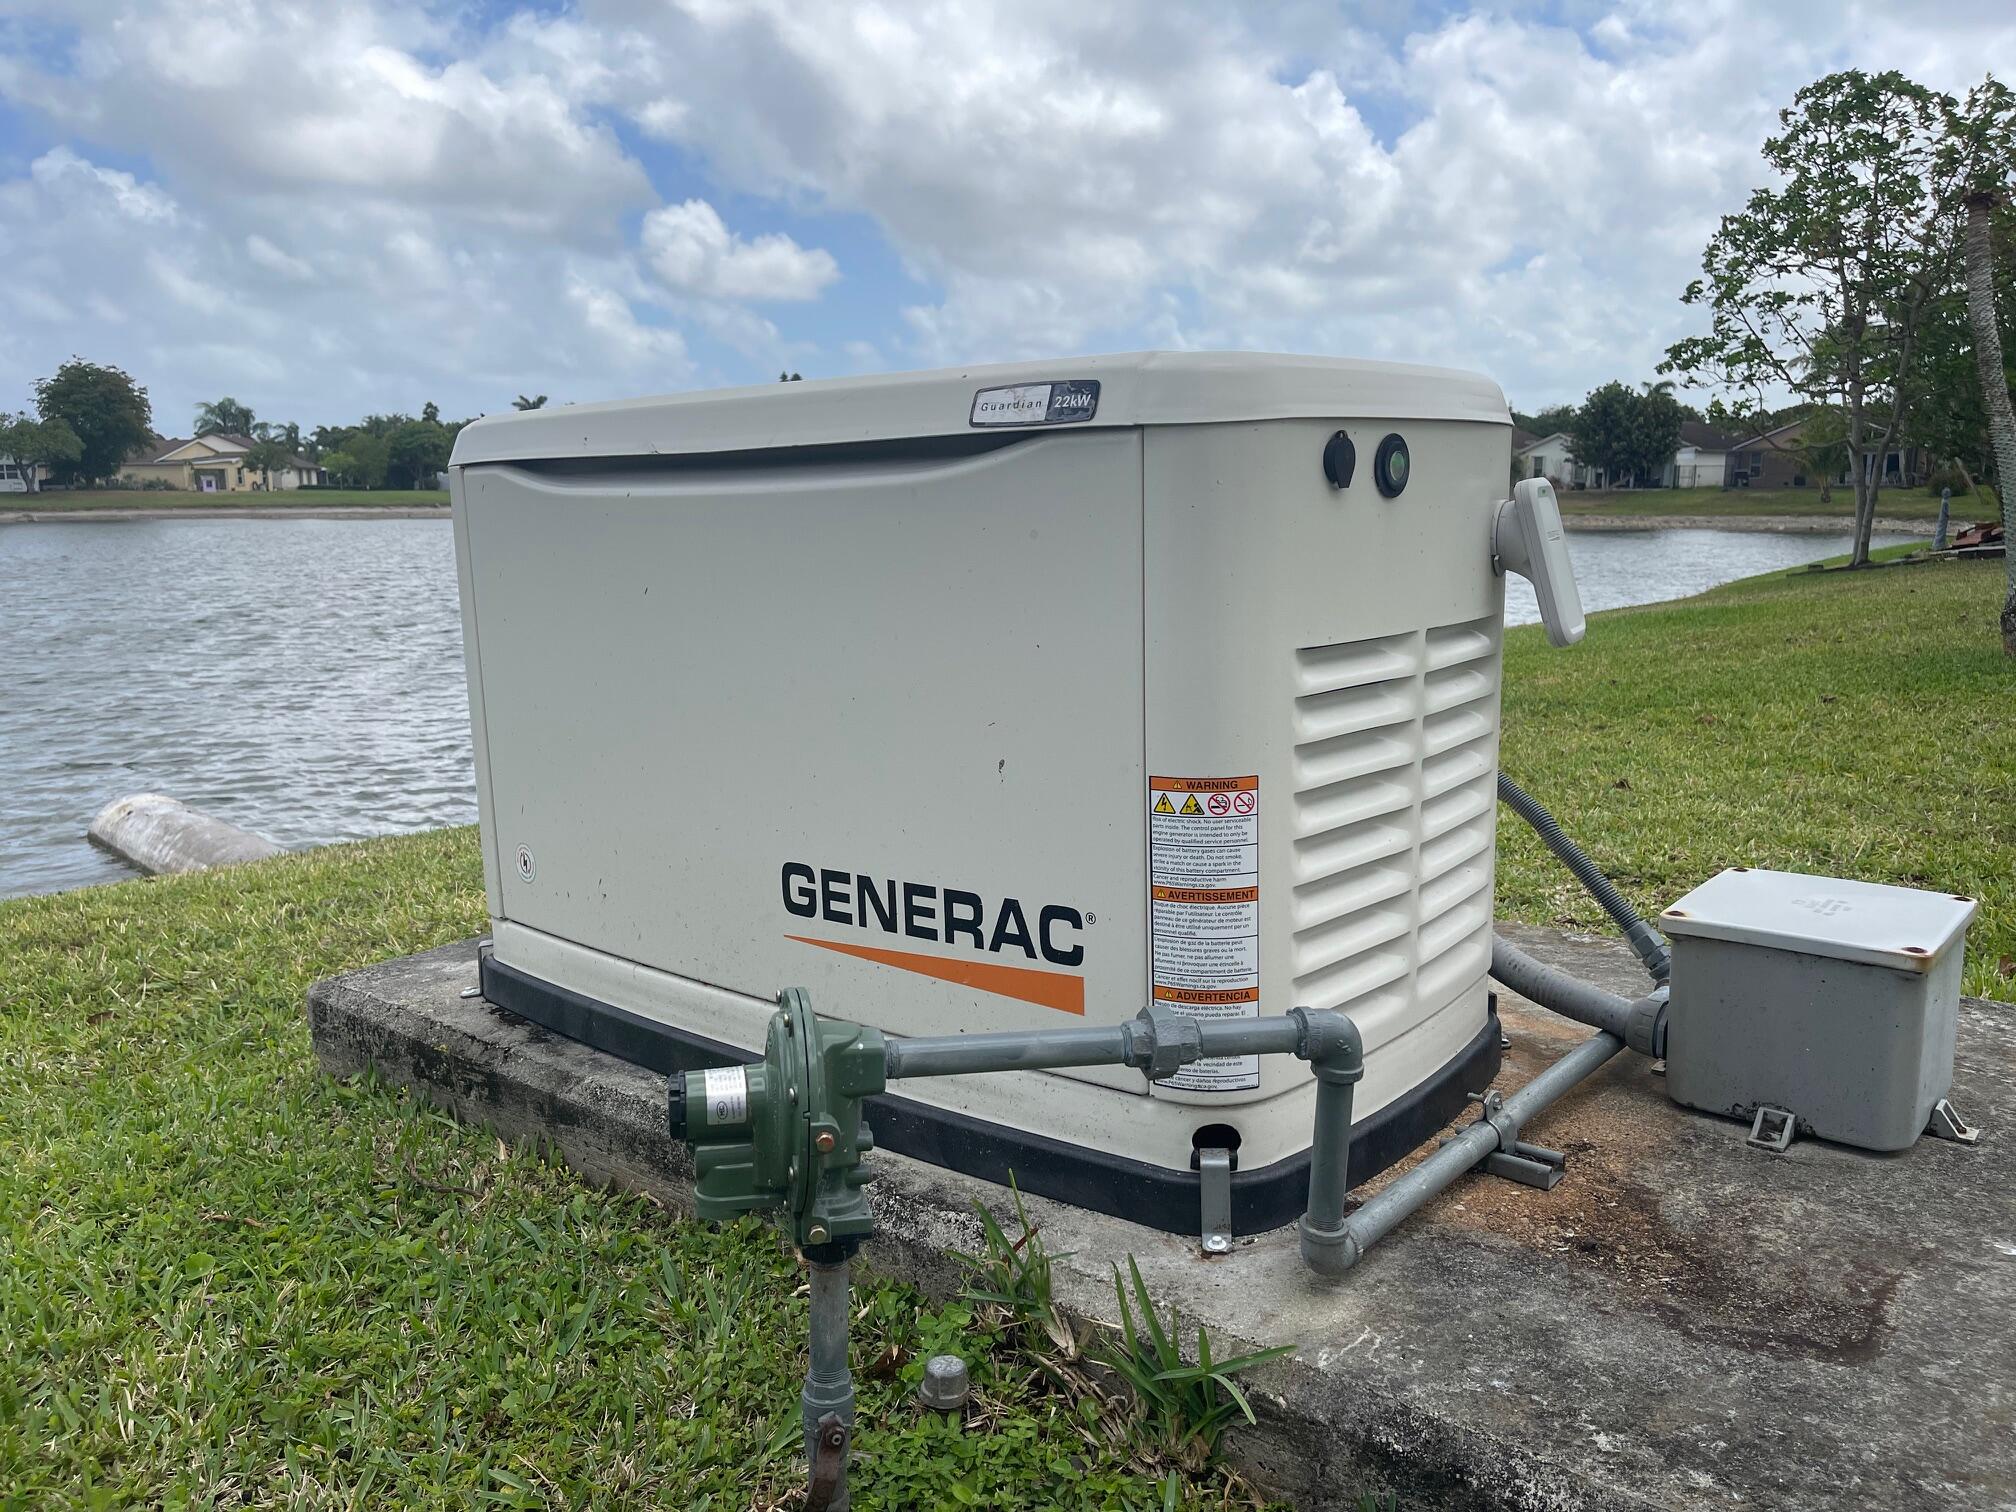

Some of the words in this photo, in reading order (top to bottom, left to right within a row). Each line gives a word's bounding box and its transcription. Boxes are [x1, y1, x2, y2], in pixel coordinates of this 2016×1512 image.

[981, 401, 1042, 411] Guardian
[1054, 394, 1091, 408] 22kW
[1186, 780, 1238, 790] WARNING
[1168, 890, 1254, 901] AVERTISSEMENT
[1177, 991, 1250, 1001] ADVERTENCIA
